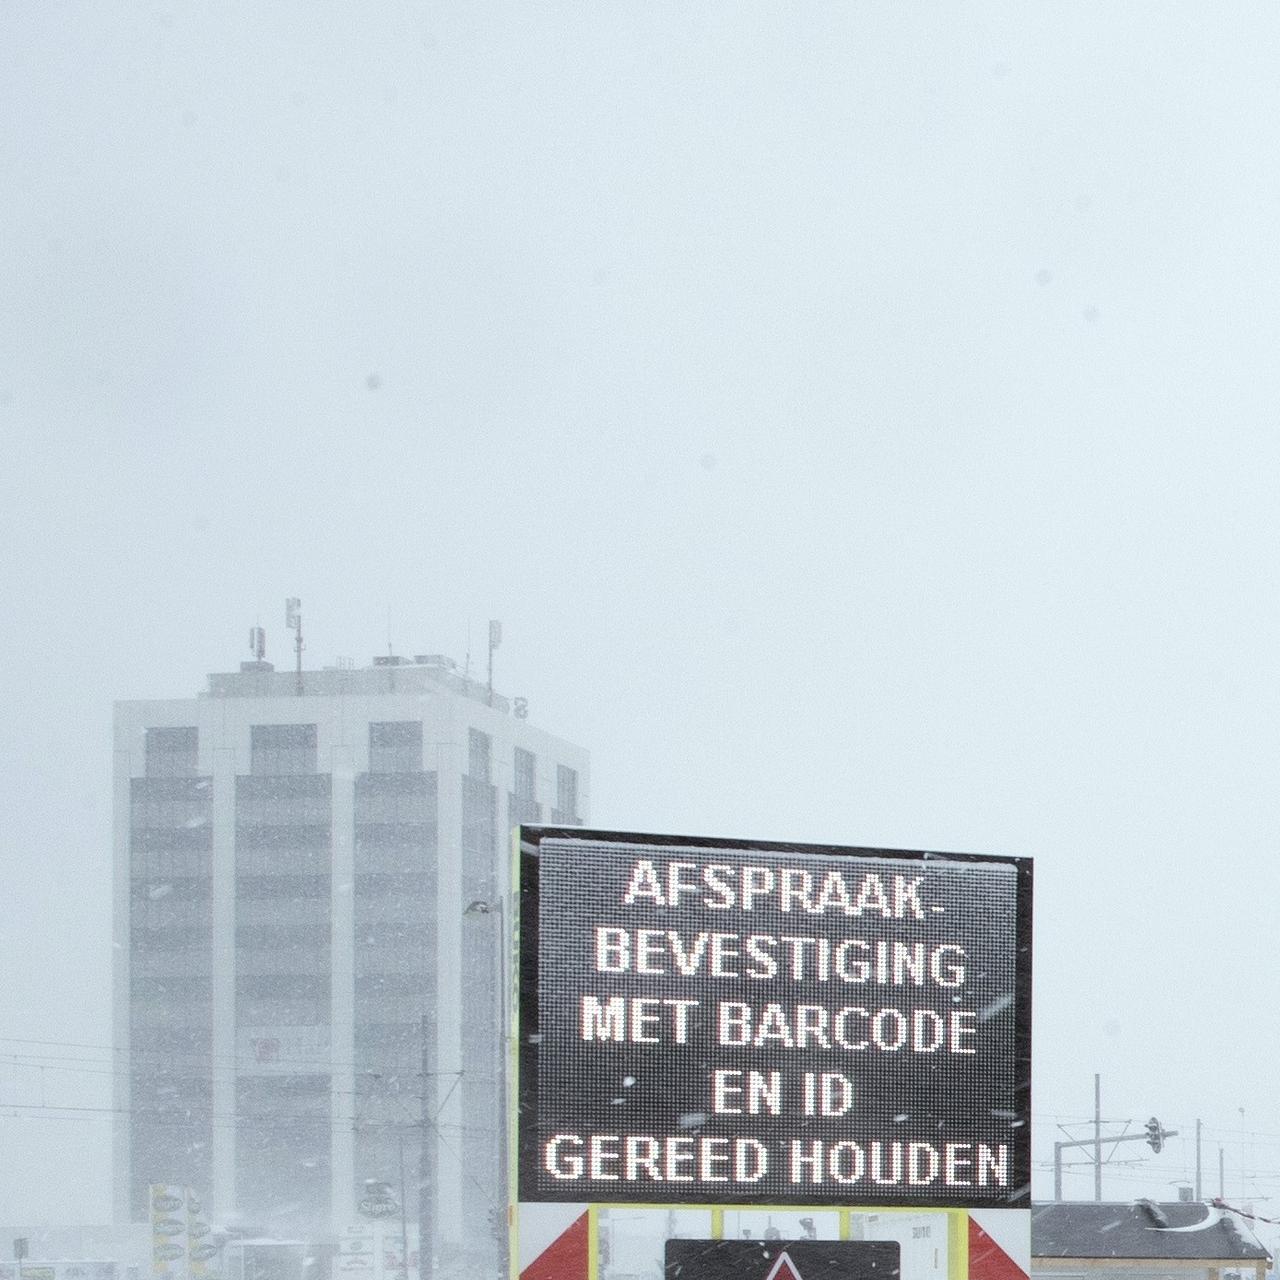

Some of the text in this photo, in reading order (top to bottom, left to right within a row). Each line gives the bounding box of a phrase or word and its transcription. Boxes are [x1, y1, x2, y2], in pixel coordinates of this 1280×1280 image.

[624, 859, 946, 919] AFSPRAAK-
[594, 927, 967, 987] BEVESTIGING
[580, 996, 977, 1055] MET BARCODE
[713, 1069, 853, 1118] EN ID
[543, 1133, 1010, 1187] GEREED HOUDEN
